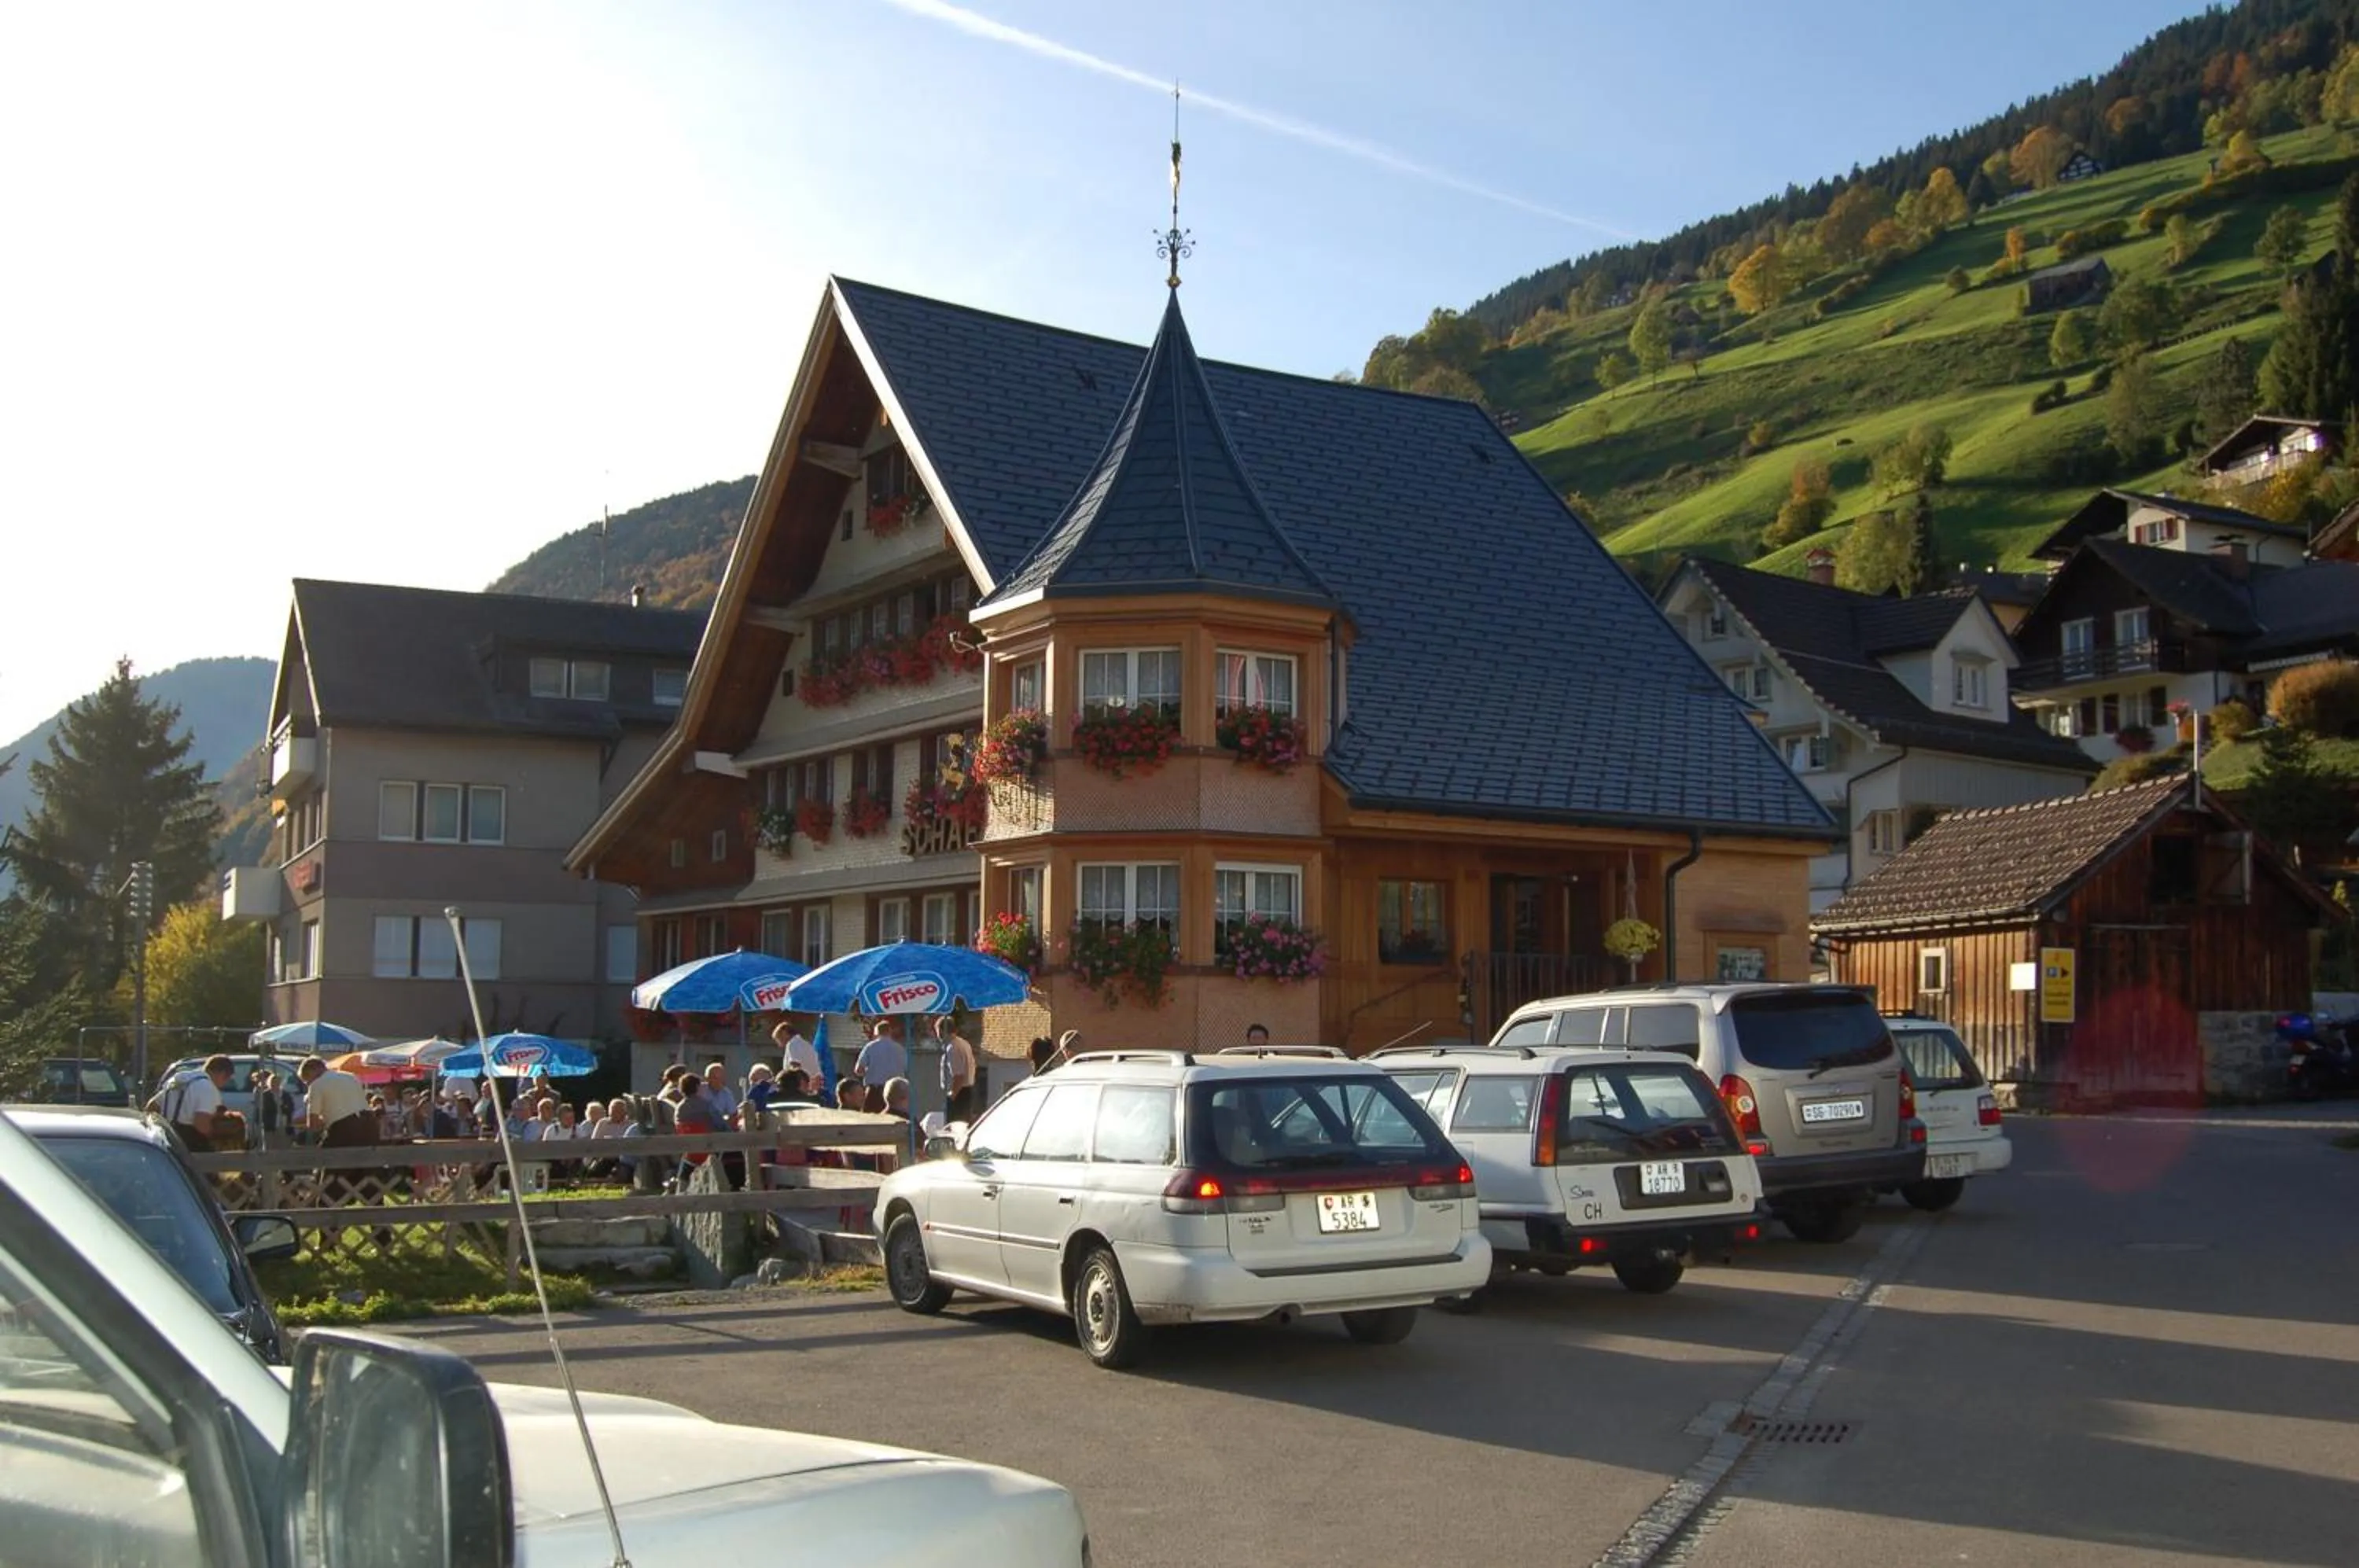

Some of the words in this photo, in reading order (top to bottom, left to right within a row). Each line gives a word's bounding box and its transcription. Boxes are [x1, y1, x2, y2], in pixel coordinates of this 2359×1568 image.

[756, 985, 789, 1007] Fris
[878, 985, 938, 1009] Frisco
[1648, 1176, 1680, 1194] 18770
[1341, 1197, 1354, 1209] AR
[1584, 1202, 1603, 1220] CH
[1332, 1212, 1367, 1230] 5384
